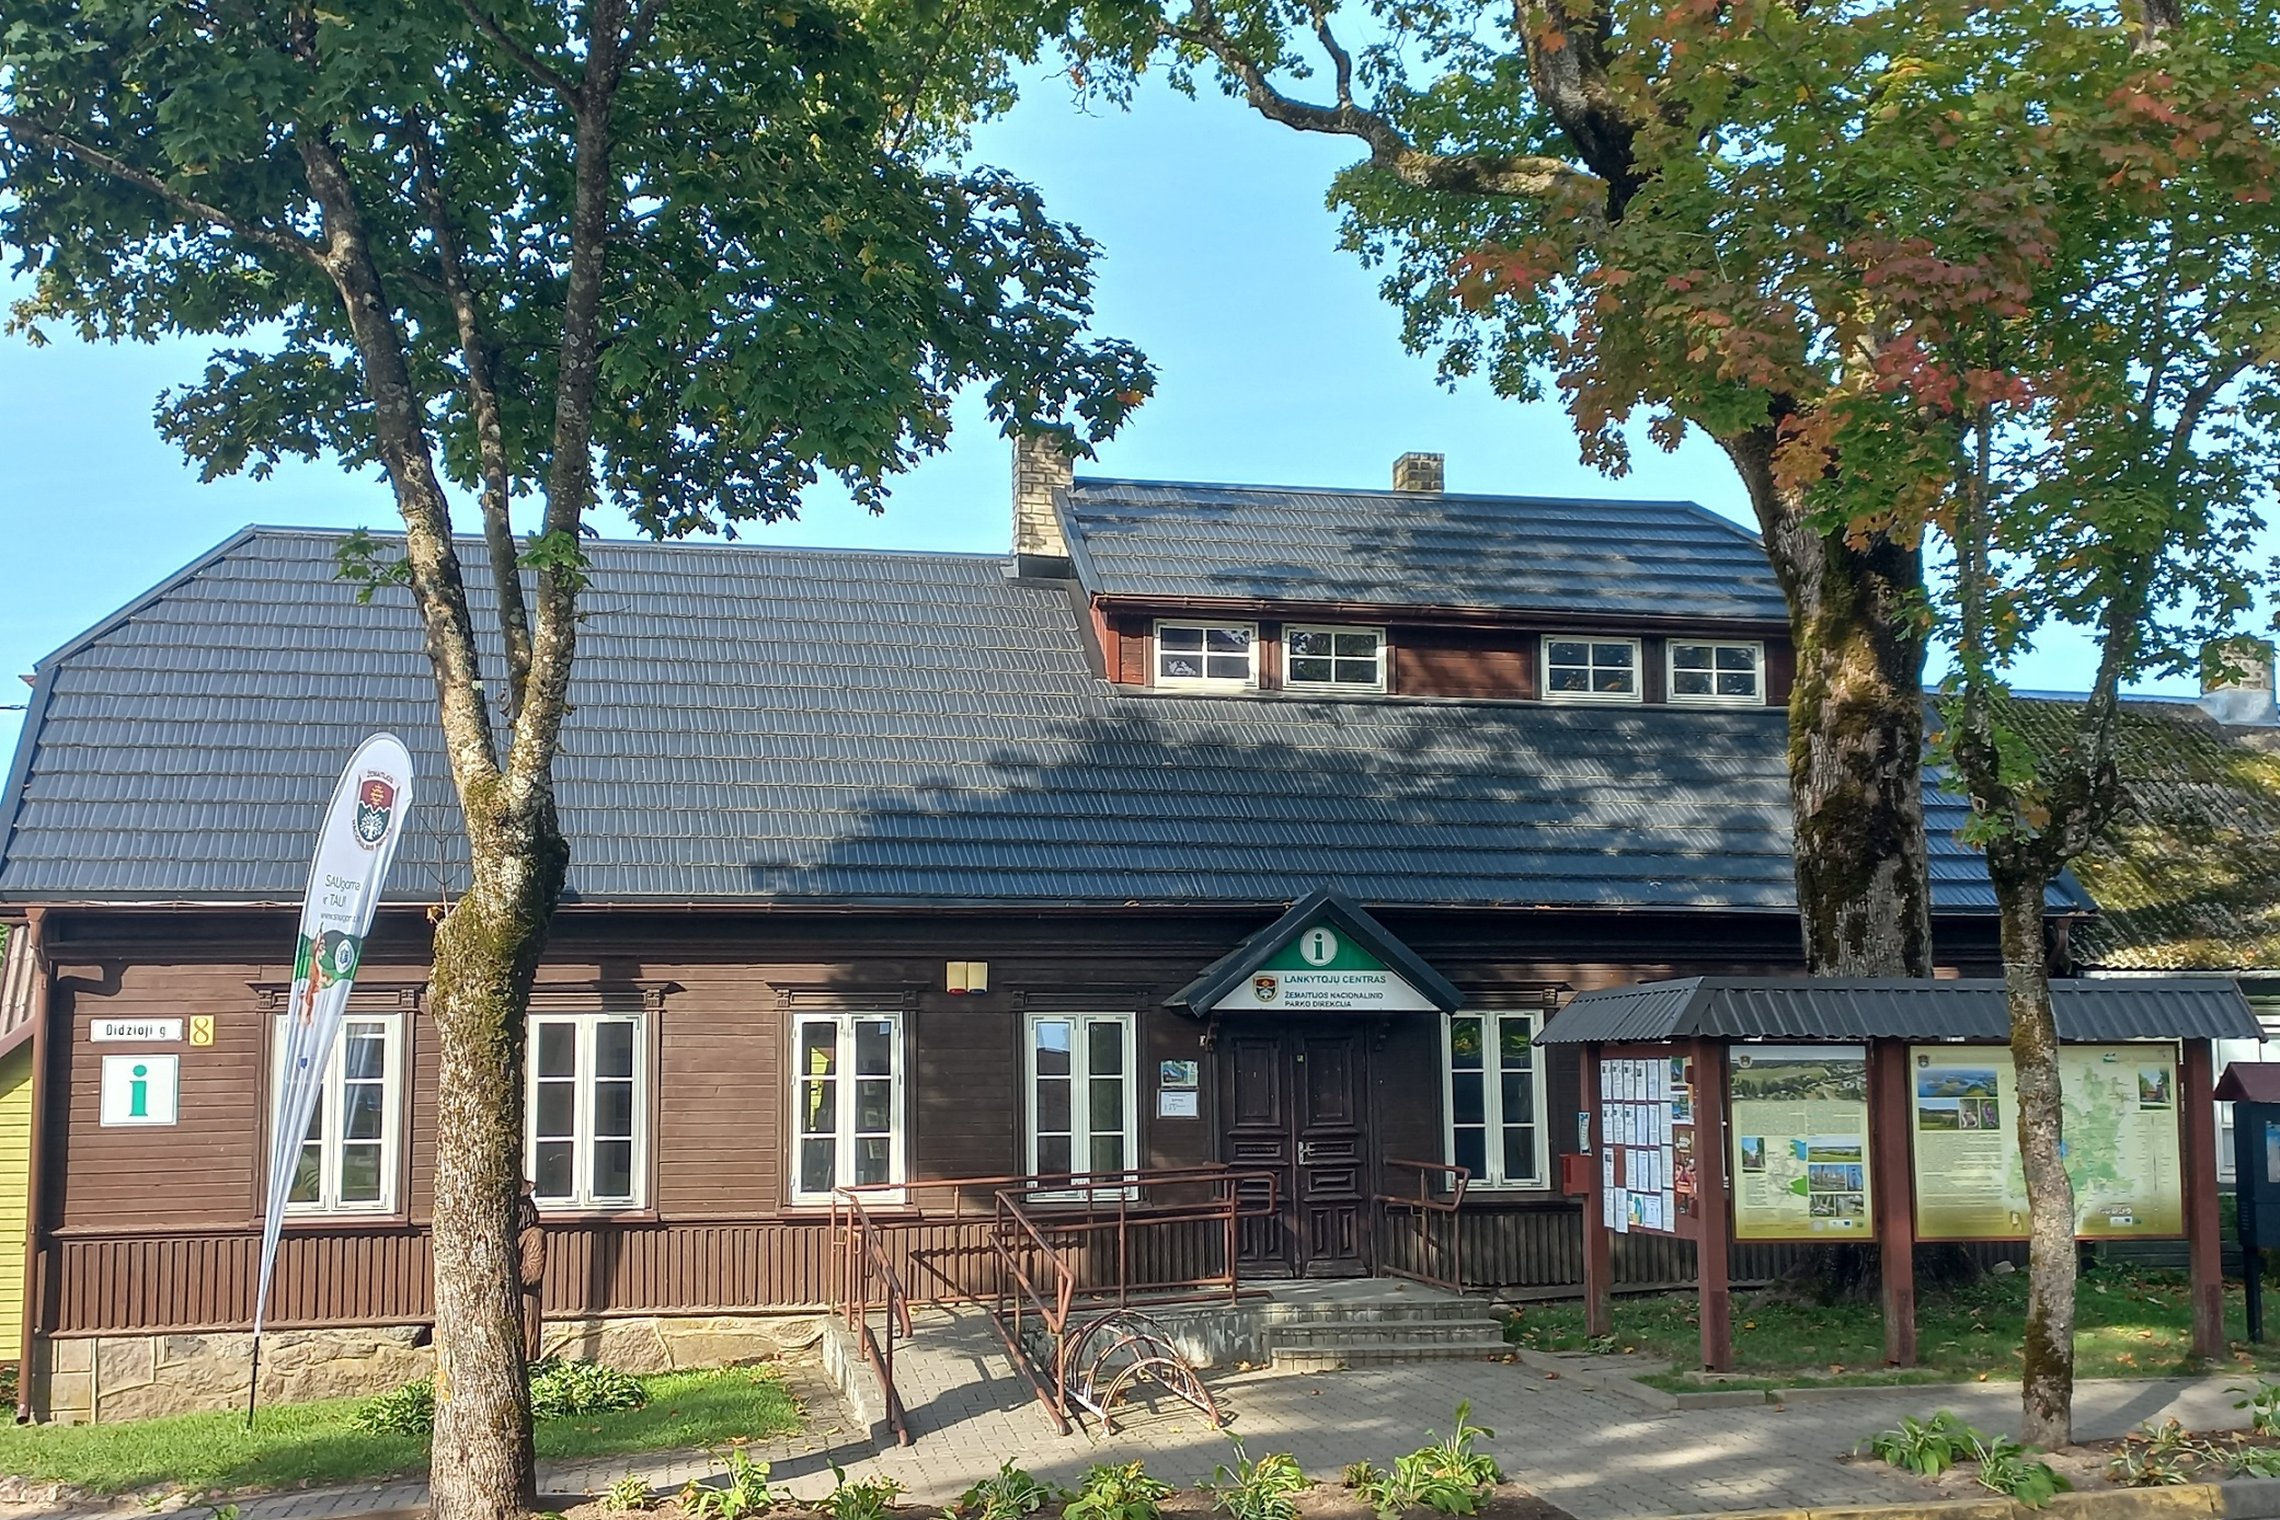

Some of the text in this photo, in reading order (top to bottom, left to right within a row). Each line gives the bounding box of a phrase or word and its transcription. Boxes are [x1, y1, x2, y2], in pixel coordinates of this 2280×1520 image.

[1284, 975, 1387, 987] LANKYTOJŲ CENTRAS
[1284, 989, 1384, 1000] ŽEMAITIJOS NACIONALINIO
[1284, 1000, 1352, 1008] PARKO DIREKCIJA
[193, 1016, 210, 1044] 8
